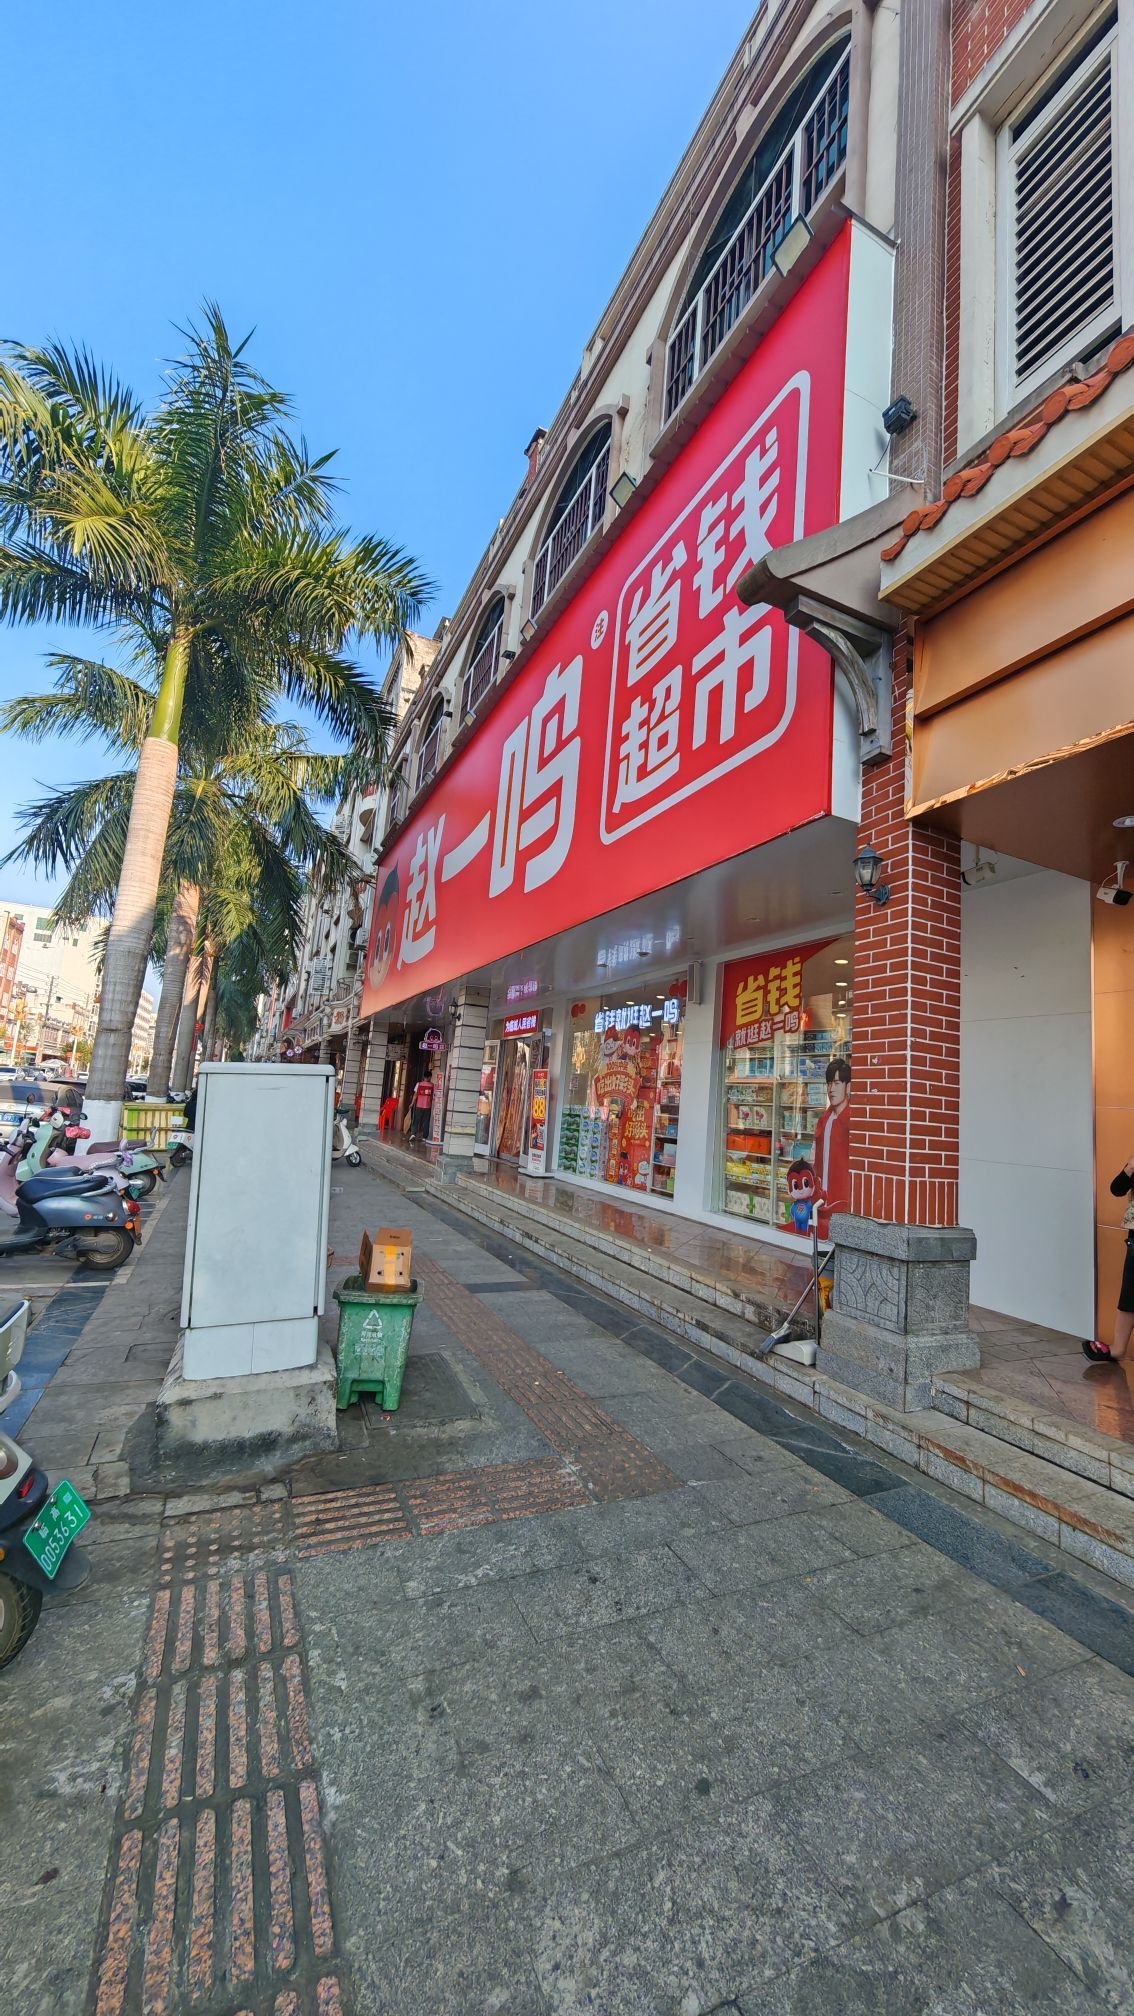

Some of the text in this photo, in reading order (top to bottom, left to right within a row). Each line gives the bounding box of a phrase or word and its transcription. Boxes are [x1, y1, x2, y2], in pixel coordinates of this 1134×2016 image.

[625, 426, 781, 687] 省钱
[612, 602, 773, 813] 超市
[398, 654, 584, 970] 赵一鸣
[594, 998, 680, 1033] 省钱就逛赵一鸣
[736, 956, 801, 1026] 省钱
[734, 1011, 799, 1048] 就逛赵一鸣
[40, 1504, 83, 1571] 0053631
